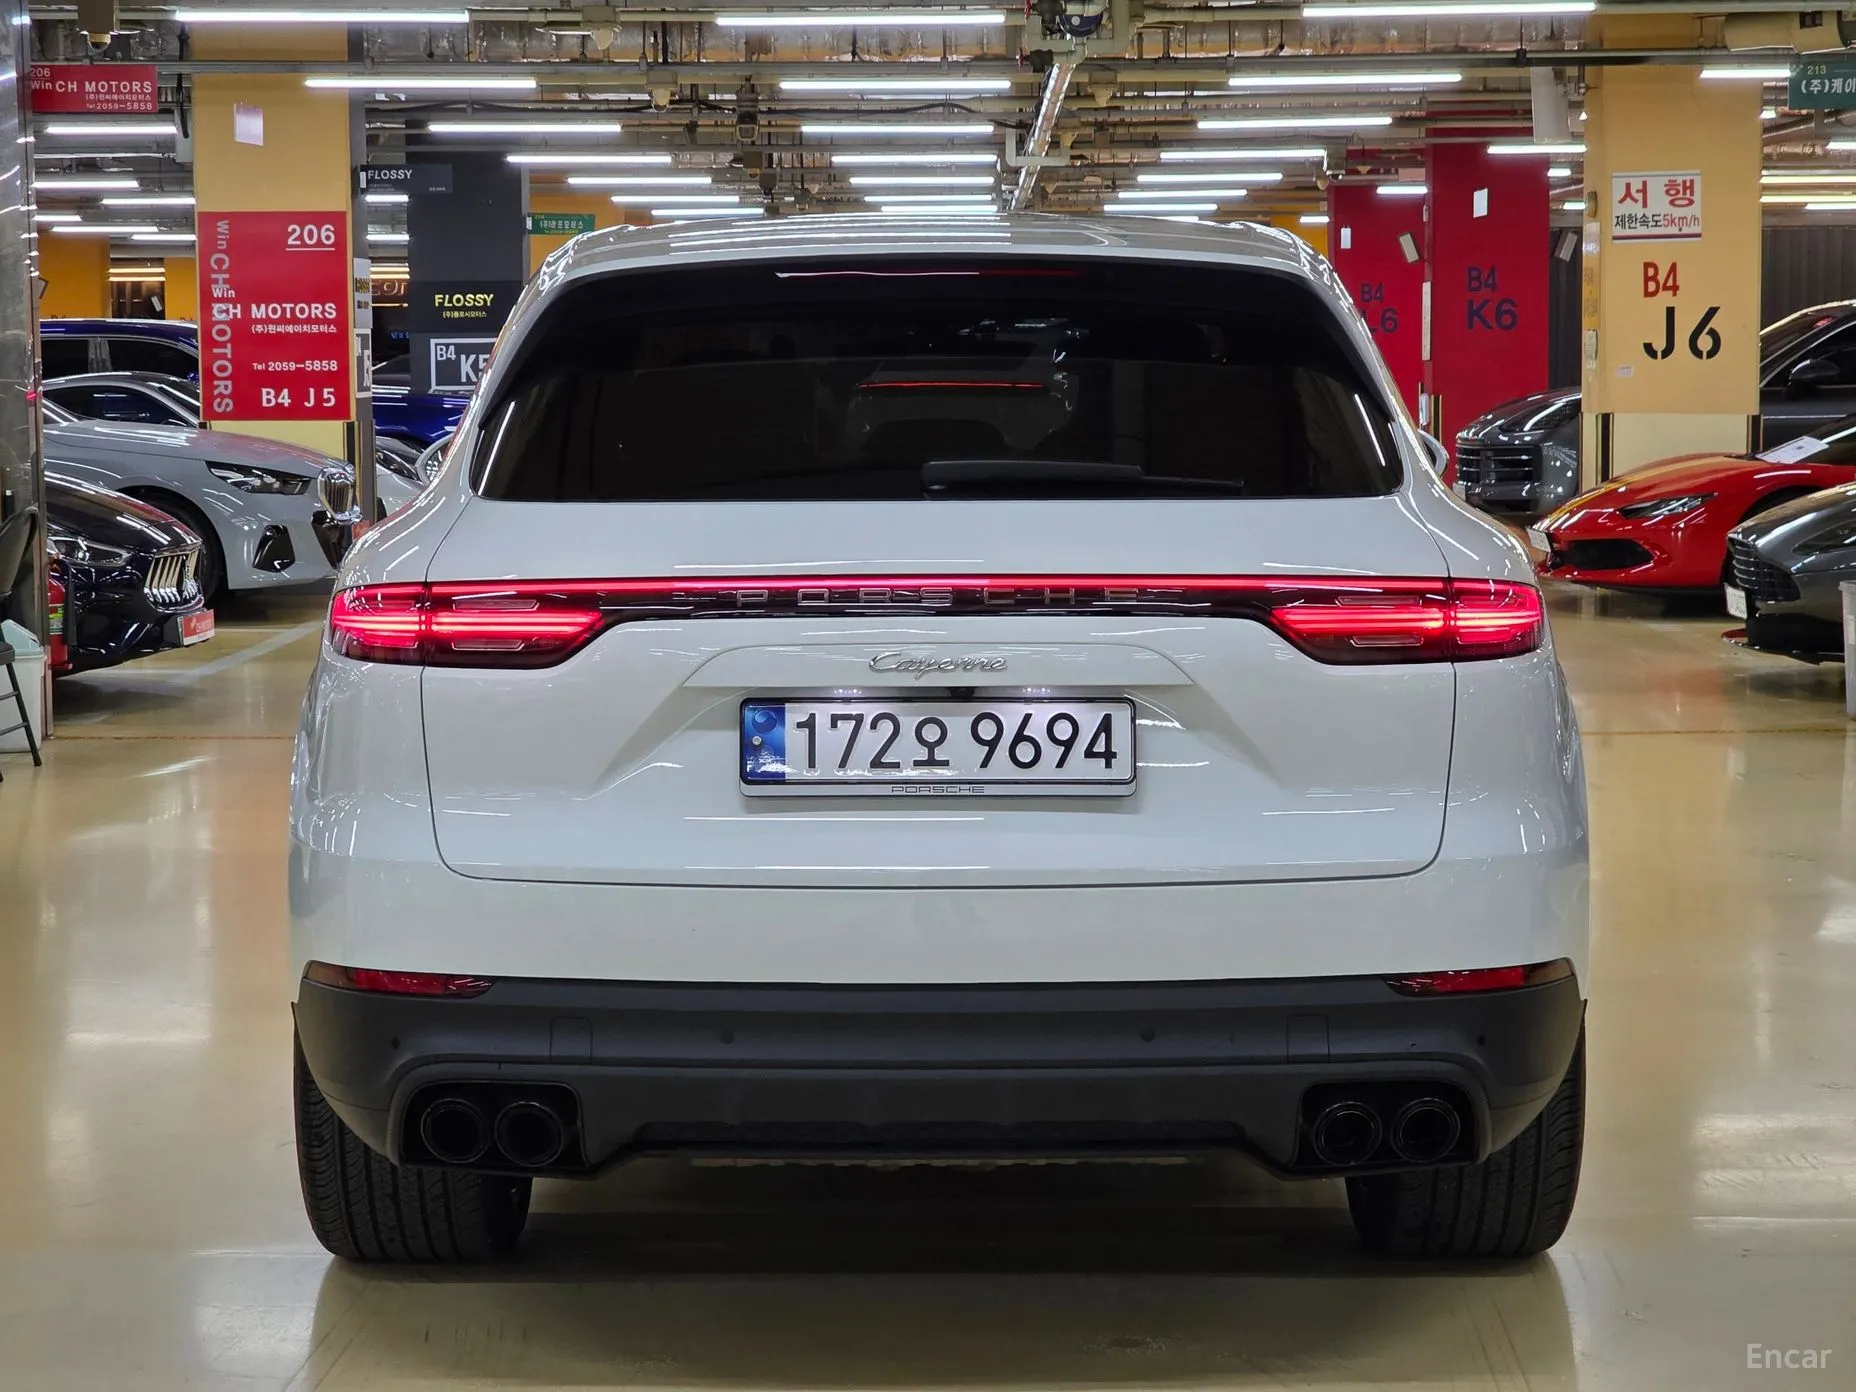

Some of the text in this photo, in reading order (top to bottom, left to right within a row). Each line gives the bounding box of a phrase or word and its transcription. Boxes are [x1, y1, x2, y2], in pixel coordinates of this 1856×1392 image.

[30, 67, 51, 78] 206
[1807, 65, 1827, 75] 213
[31, 80, 153, 93] Win CH MOTORS
[367, 169, 413, 180] FLOSSY
[216, 220, 230, 250] Win
[287, 224, 336, 245] 206
[210, 253, 231, 289] CH
[1467, 266, 1497, 292] B4
[1643, 262, 1680, 298] B4
[212, 287, 236, 298] Win
[434, 293, 494, 307] FLOSSY
[1360, 283, 1385, 303] B4
[213, 303, 337, 319] CH MOTORS
[1467, 298, 1518, 331] K6
[436, 345, 456, 361] B4
[252, 360, 338, 371] Tel 2059-5858
[261, 388, 292, 407] B4
[737, 586, 1139, 607] PORSCHE
[869, 651, 1009, 681] Cayenne
[795, 711, 1118, 769] 172오 9694
[891, 785, 985, 794] PORSCHE
